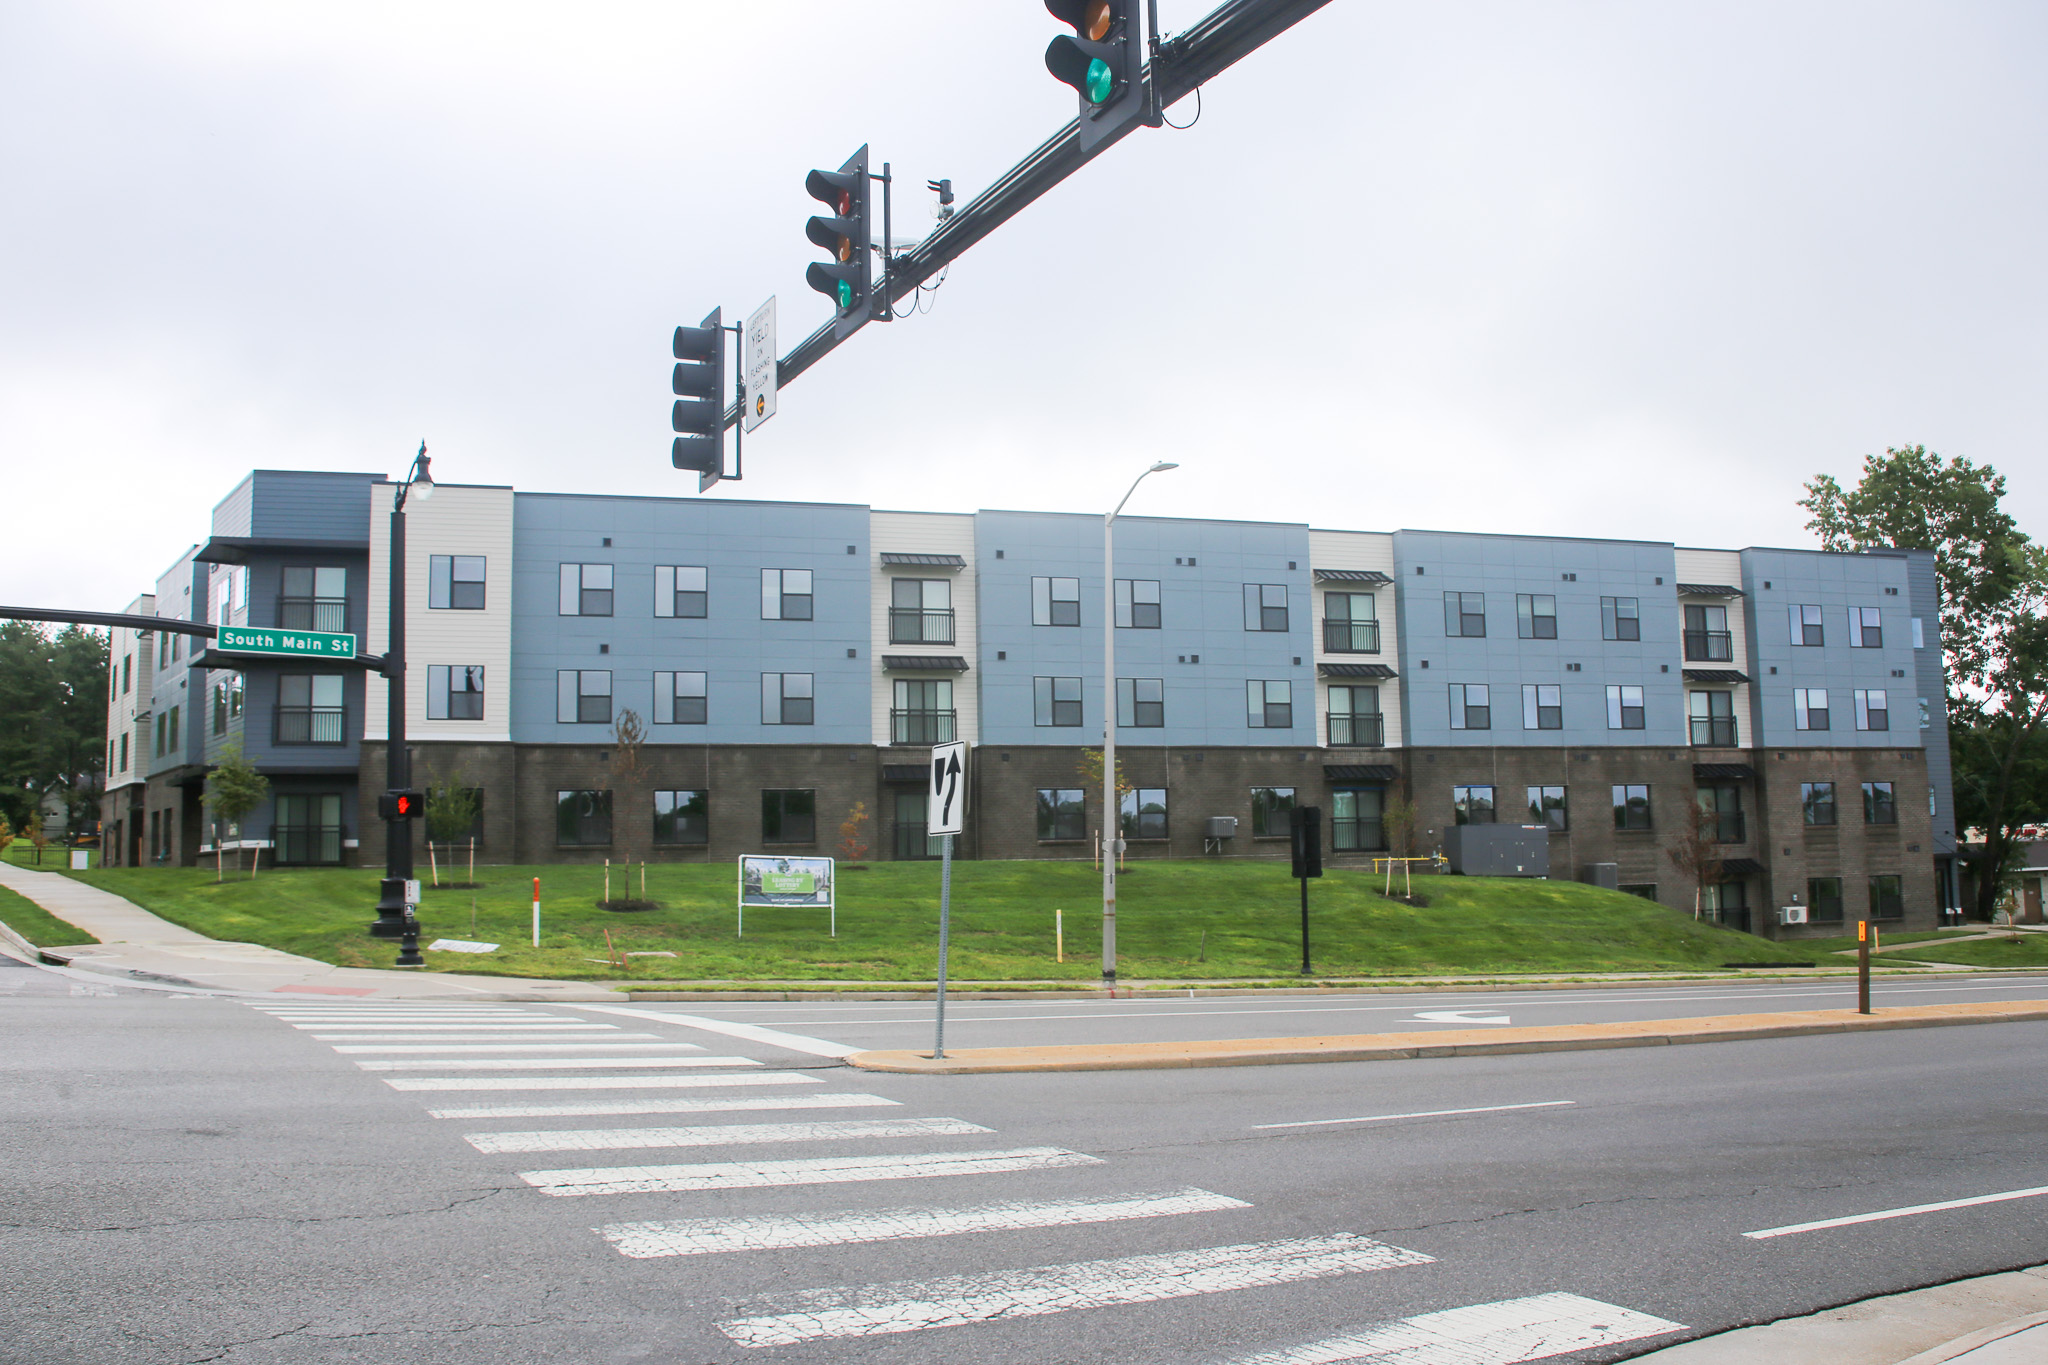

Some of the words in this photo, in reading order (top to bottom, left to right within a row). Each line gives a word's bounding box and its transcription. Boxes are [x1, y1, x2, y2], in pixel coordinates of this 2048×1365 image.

[752, 323, 769, 347] YIELD
[757, 348, 763, 358] ON
[751, 356, 770, 378] FLASHING
[752, 373, 768, 391] YELLOW
[224, 632, 274, 647] South
[282, 636, 322, 650] Main
[331, 639, 349, 652] St
